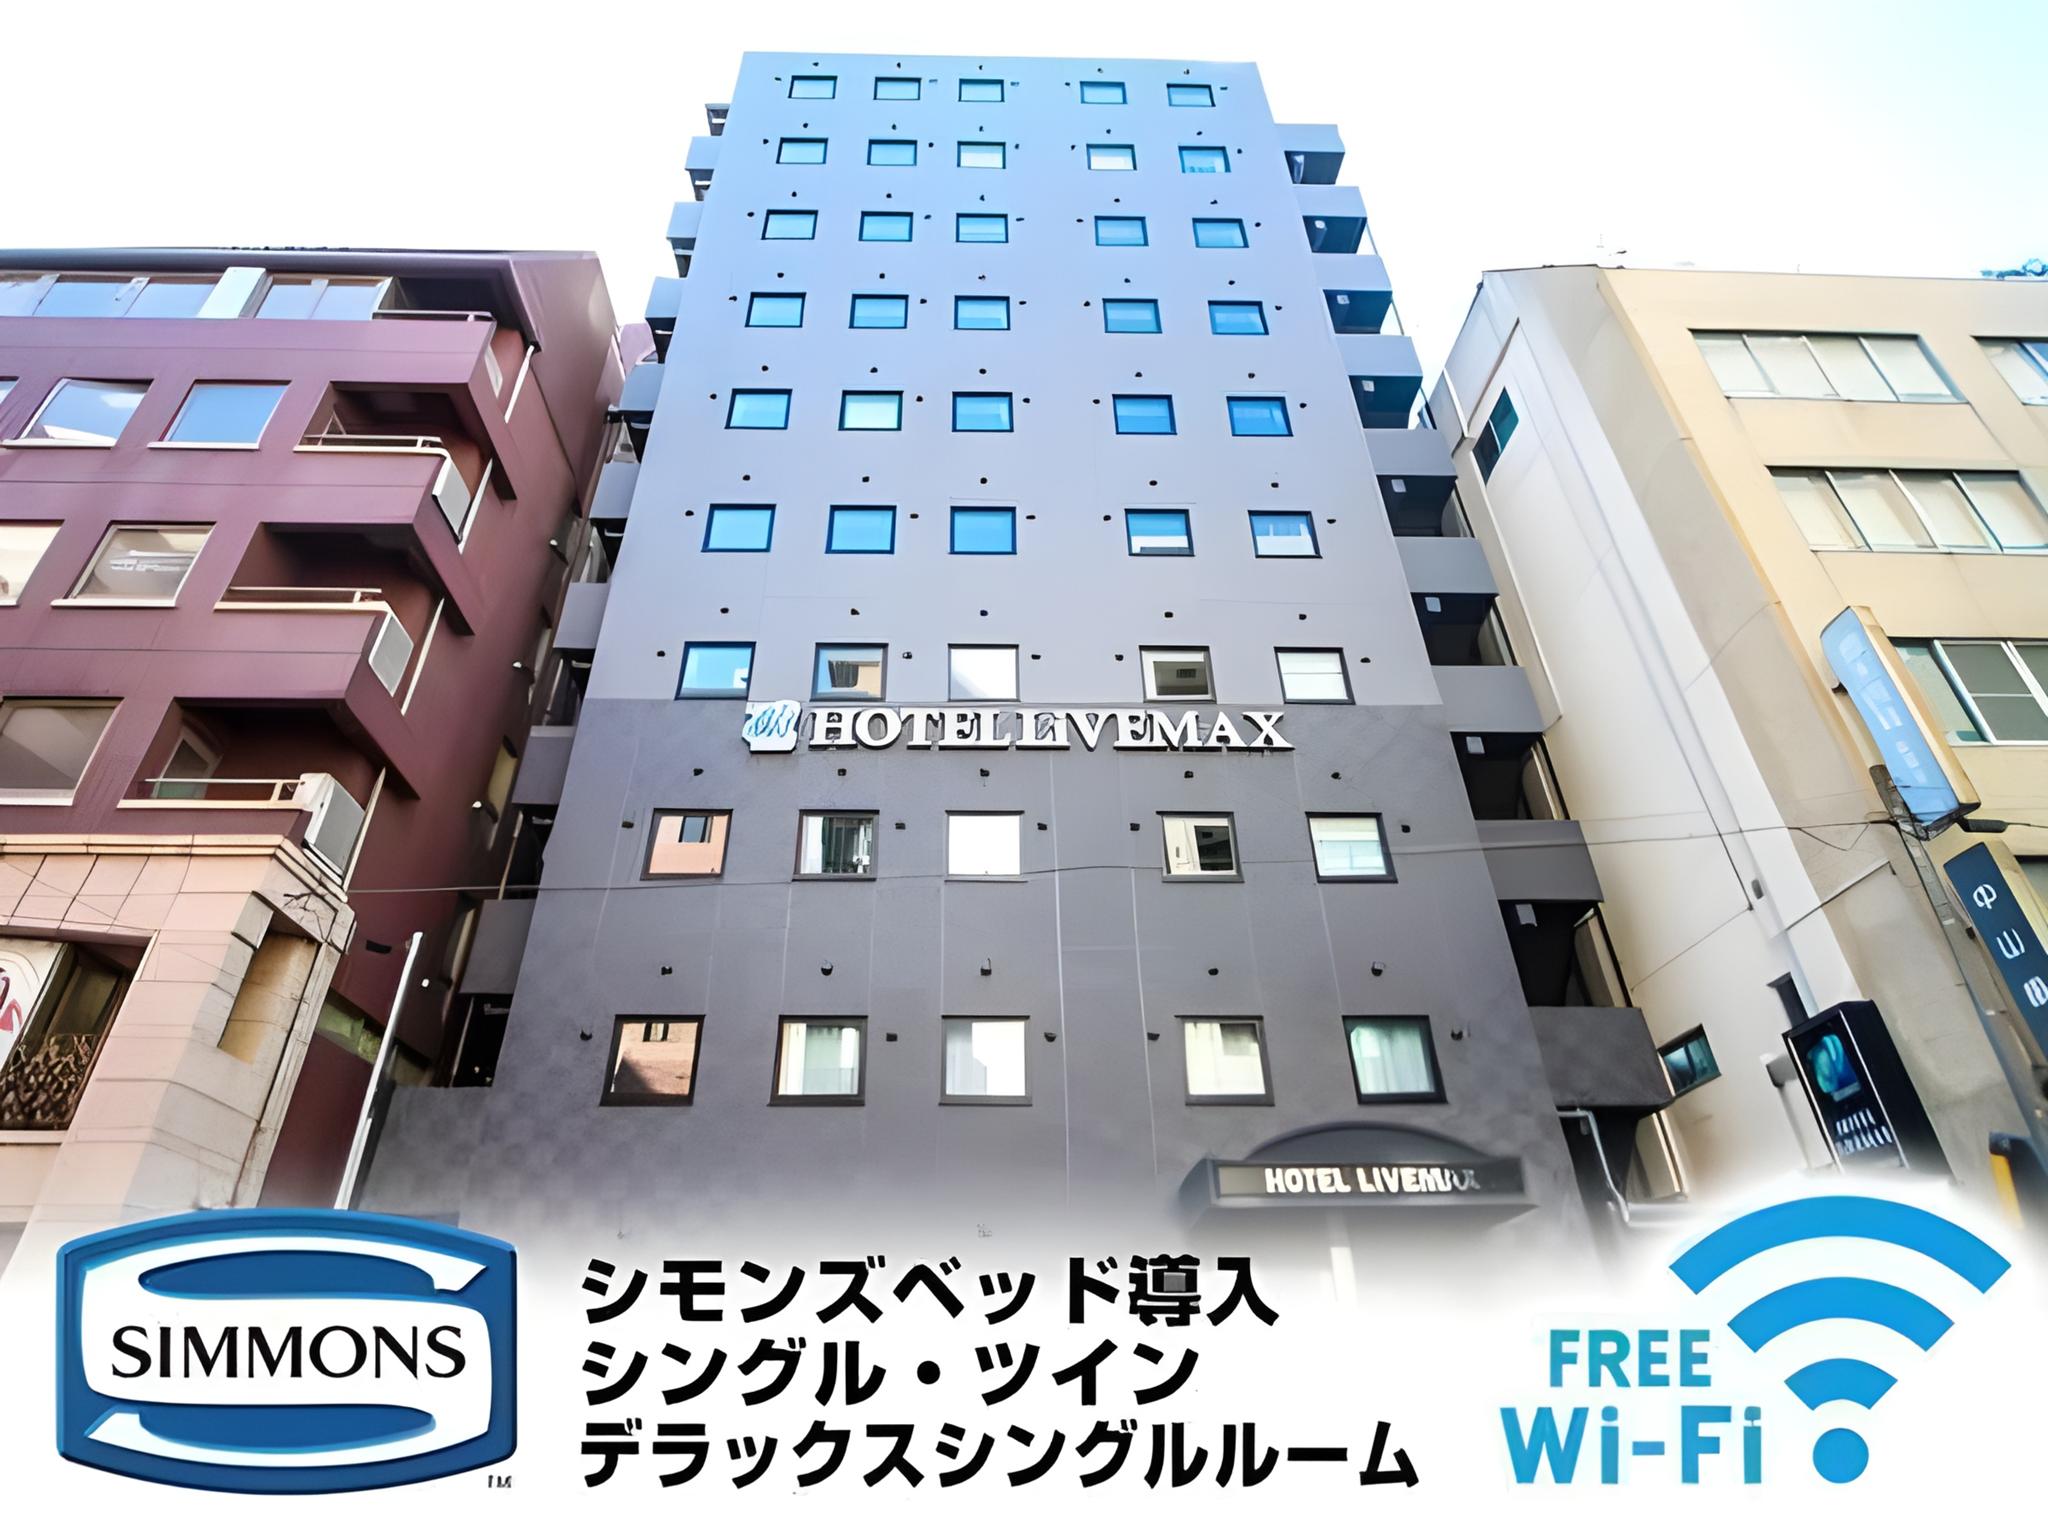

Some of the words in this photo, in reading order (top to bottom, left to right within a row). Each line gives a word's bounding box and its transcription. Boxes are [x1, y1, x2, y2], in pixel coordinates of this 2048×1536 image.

[808, 707, 1012, 751] HOTEL
[1015, 707, 1296, 752] LIVEMAX
[1264, 1167, 1352, 1193] HOTEL
